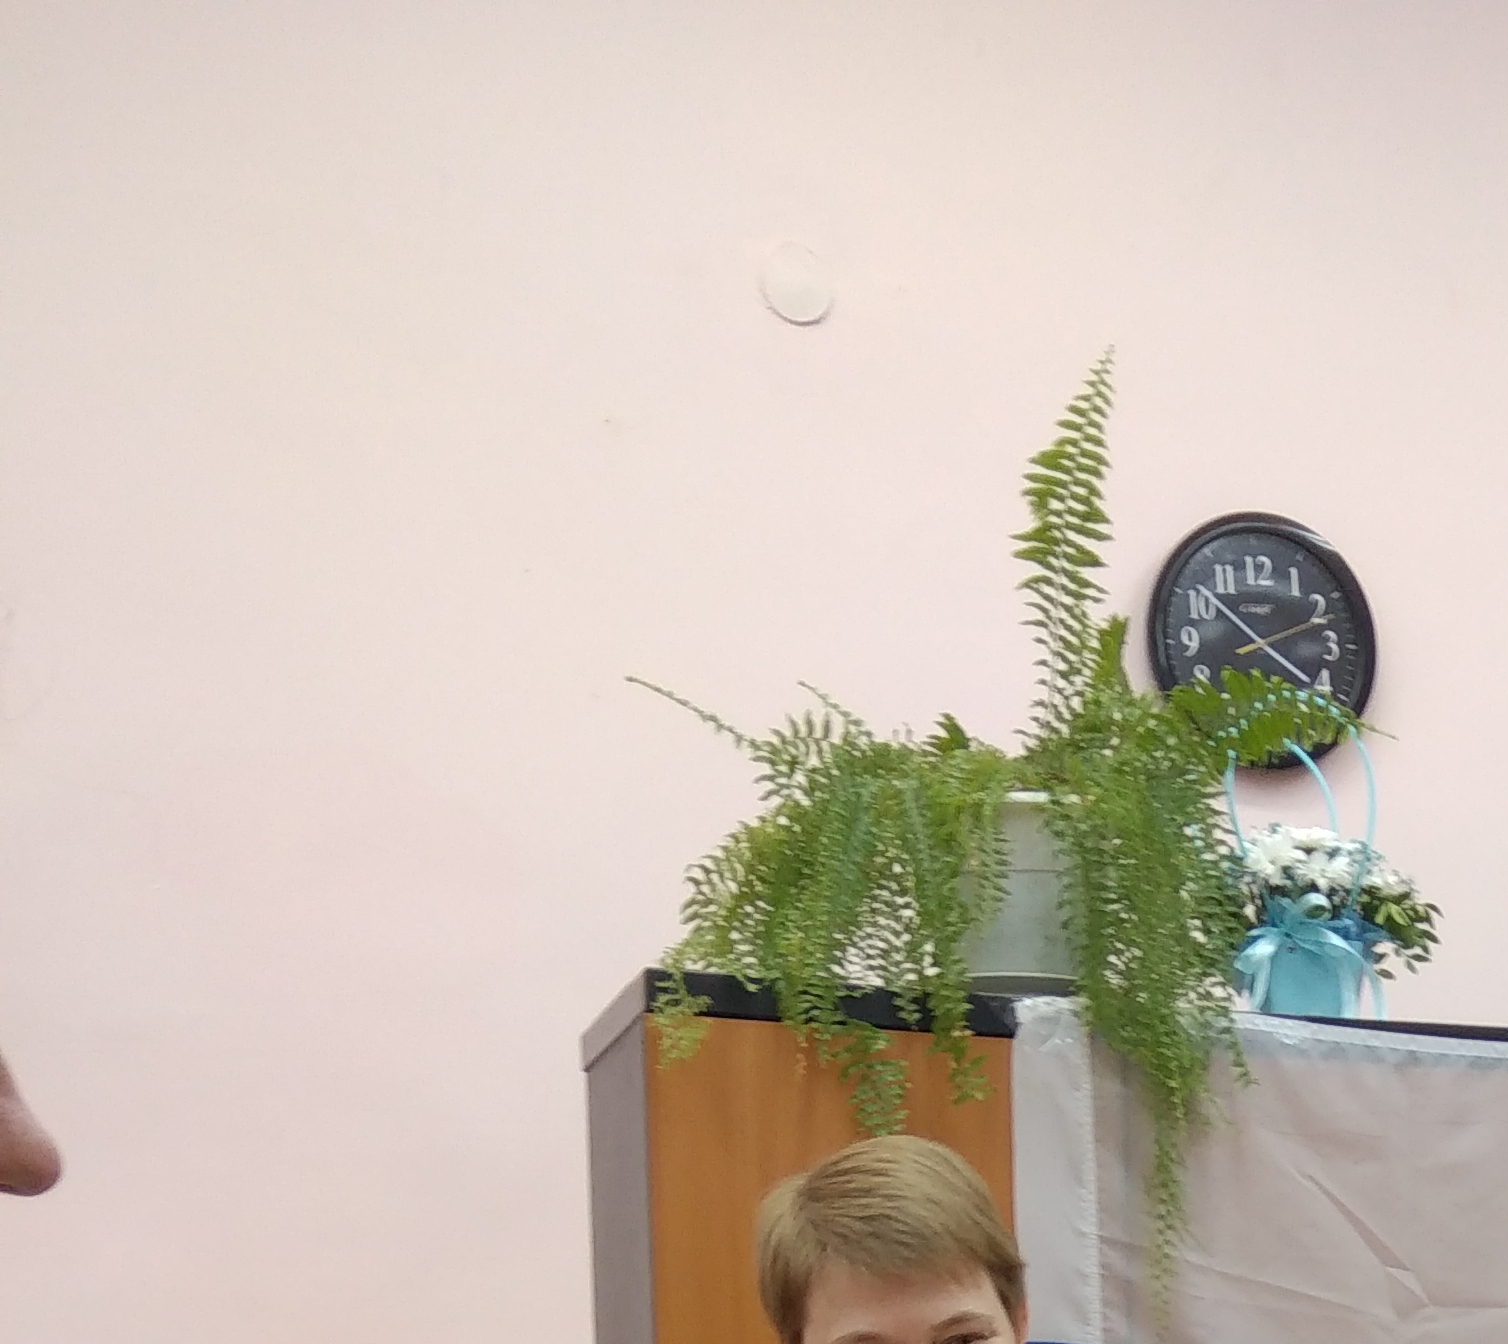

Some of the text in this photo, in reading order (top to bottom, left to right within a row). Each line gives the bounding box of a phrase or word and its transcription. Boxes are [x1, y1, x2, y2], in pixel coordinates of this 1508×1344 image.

[1214, 564, 1238, 595] 11
[1244, 555, 1274, 586] 12
[1288, 567, 1302, 598] 1
[1188, 589, 1217, 621] 10
[1309, 594, 1328, 625] 2
[1180, 626, 1201, 657] 9
[1321, 630, 1340, 661] 3
[1314, 668, 1333, 692] 4
